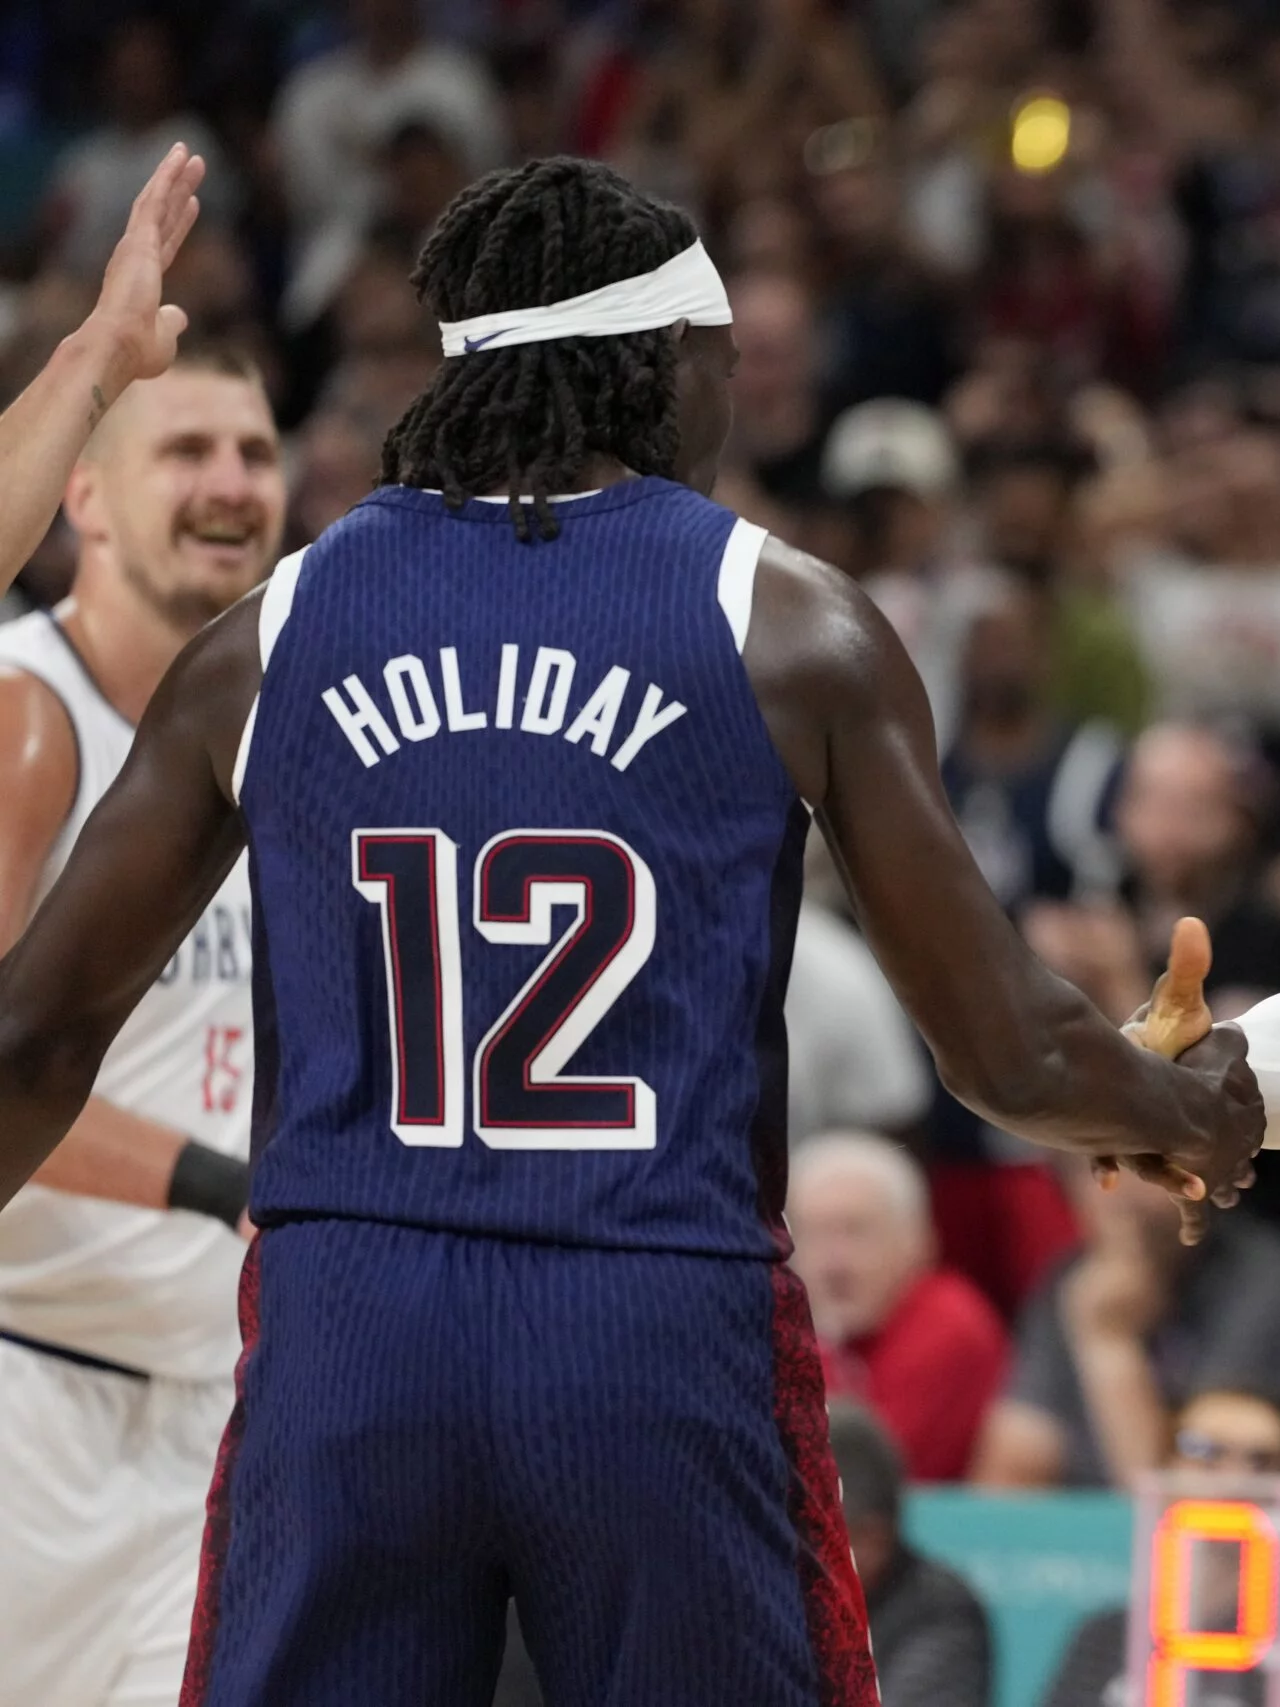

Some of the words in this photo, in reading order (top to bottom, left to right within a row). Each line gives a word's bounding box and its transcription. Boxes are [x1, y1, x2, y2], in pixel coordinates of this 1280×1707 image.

[321, 643, 687, 772] HOLIDAY
[351, 827, 656, 1150] 12
[202, 1023, 242, 1114] 15
